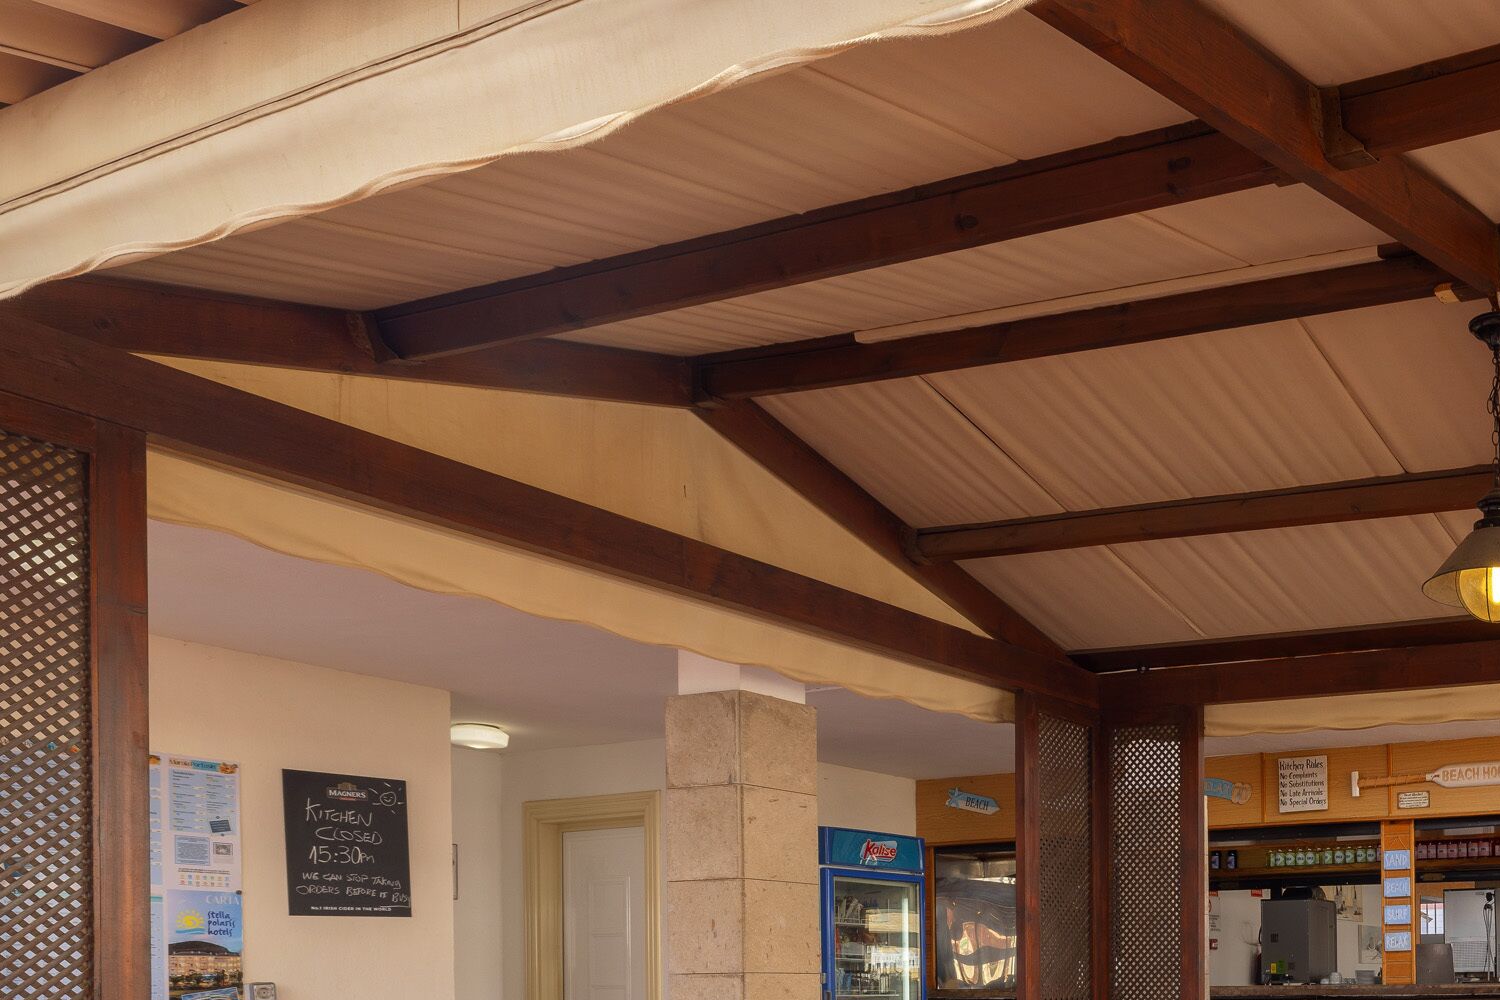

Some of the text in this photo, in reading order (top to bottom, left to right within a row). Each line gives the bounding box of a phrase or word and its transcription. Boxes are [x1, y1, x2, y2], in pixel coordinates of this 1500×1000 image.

[1279, 758, 1324, 771] Kitchen Rules
[1280, 771, 1318, 780] No Complaints
[1441, 767, 1481, 782] BEACH
[1288, 780, 1325, 788] Substitutions
[328, 788, 367, 799] MAGNERS
[1280, 788, 1324, 797] No Late Arrivals
[965, 796, 989, 811] BEACH
[1280, 796, 1327, 808] No Special Orders
[305, 797, 373, 827] KITCHEN
[315, 826, 383, 845] CLOSED
[863, 839, 897, 860] Kalise
[1385, 853, 1408, 867] SAND
[302, 872, 320, 881] WE
[322, 872, 343, 882] CAN
[346, 873, 369, 883] STOP
[295, 884, 341, 895] ORDERS
[346, 886, 377, 897] BEFORE
[1386, 883, 1408, 895] BEACH
[207, 910, 231, 920] stella
[1388, 909, 1408, 920] SURF
[207, 918, 236, 929] polaris
[207, 927, 233, 937] hotels
[1386, 935, 1409, 949] RELAX
